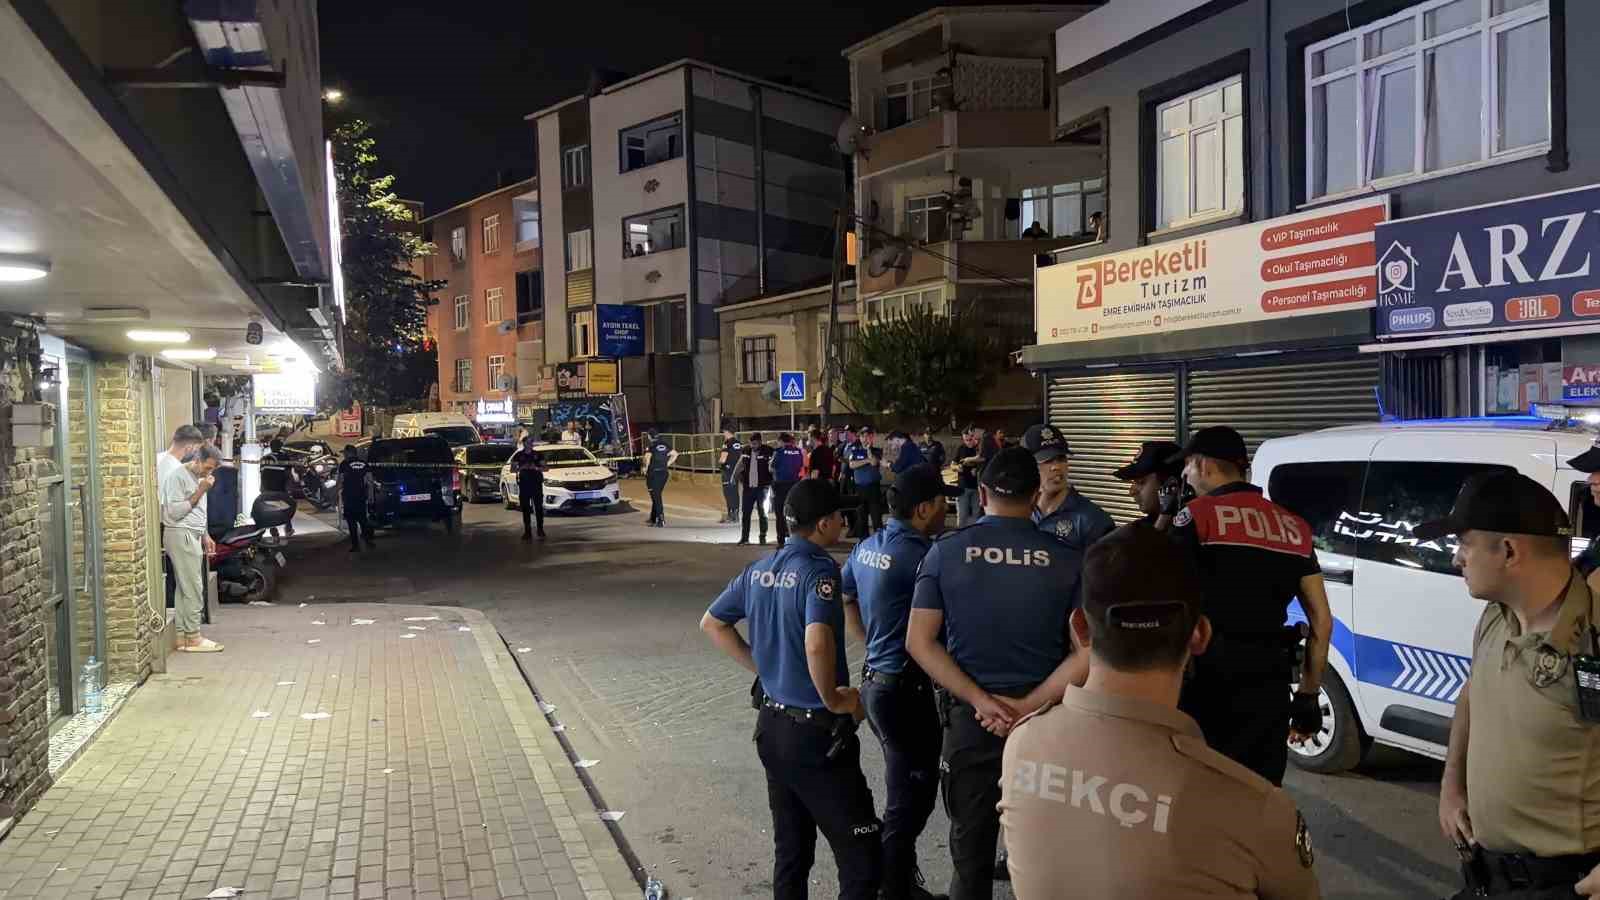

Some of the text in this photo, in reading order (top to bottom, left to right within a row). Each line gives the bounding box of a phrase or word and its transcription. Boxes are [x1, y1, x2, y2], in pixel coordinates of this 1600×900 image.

[1436, 210, 1600, 293] ARZ
[1103, 240, 1207, 286] Bereketli
[1272, 262, 1293, 275] Okul
[1141, 275, 1207, 298] Turizm
[1272, 291, 1310, 306] Personel
[1379, 291, 1416, 307] HOME
[1103, 307, 1122, 317] EMRE
[1518, 299, 1547, 318] JBL
[1392, 311, 1432, 326] PHILIPS
